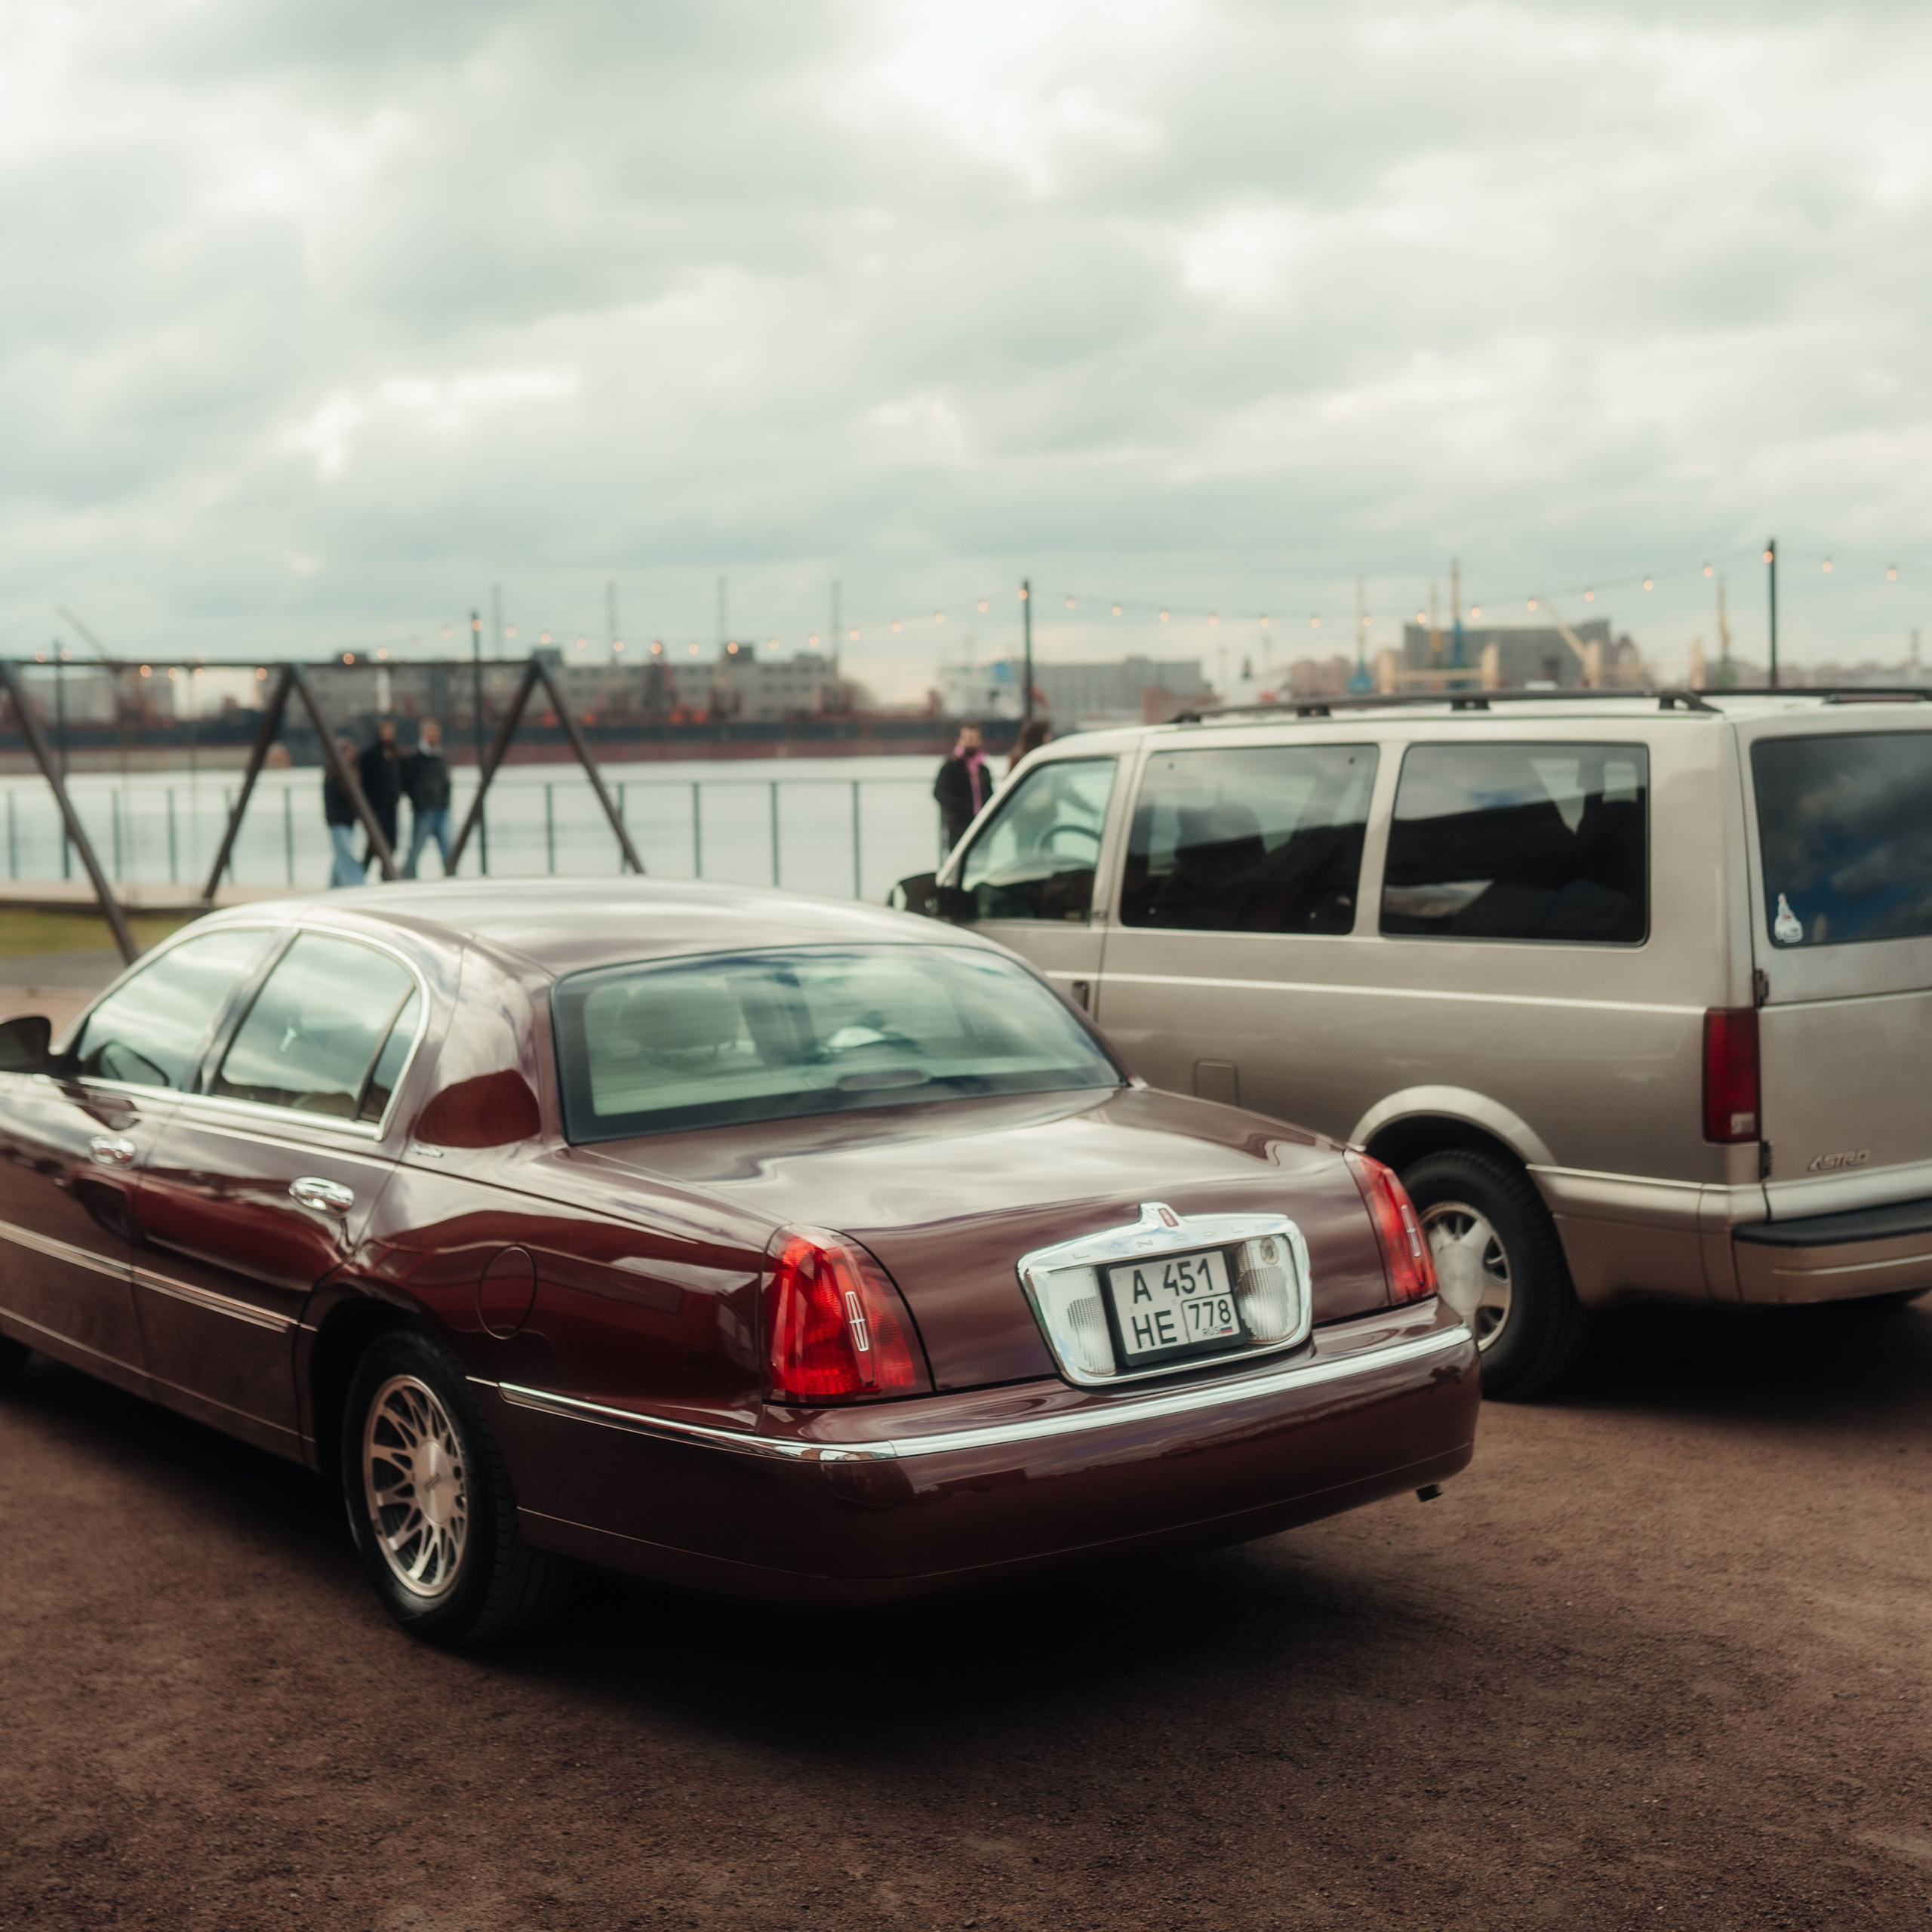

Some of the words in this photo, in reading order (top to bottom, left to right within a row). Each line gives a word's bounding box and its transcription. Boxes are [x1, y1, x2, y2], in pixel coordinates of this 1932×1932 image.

[1807, 1149, 1870, 1172] ASTRO
[1163, 1258, 1213, 1297] 451
[1188, 1299, 1232, 1330] 778
[1202, 1326, 1220, 1337] RUS
